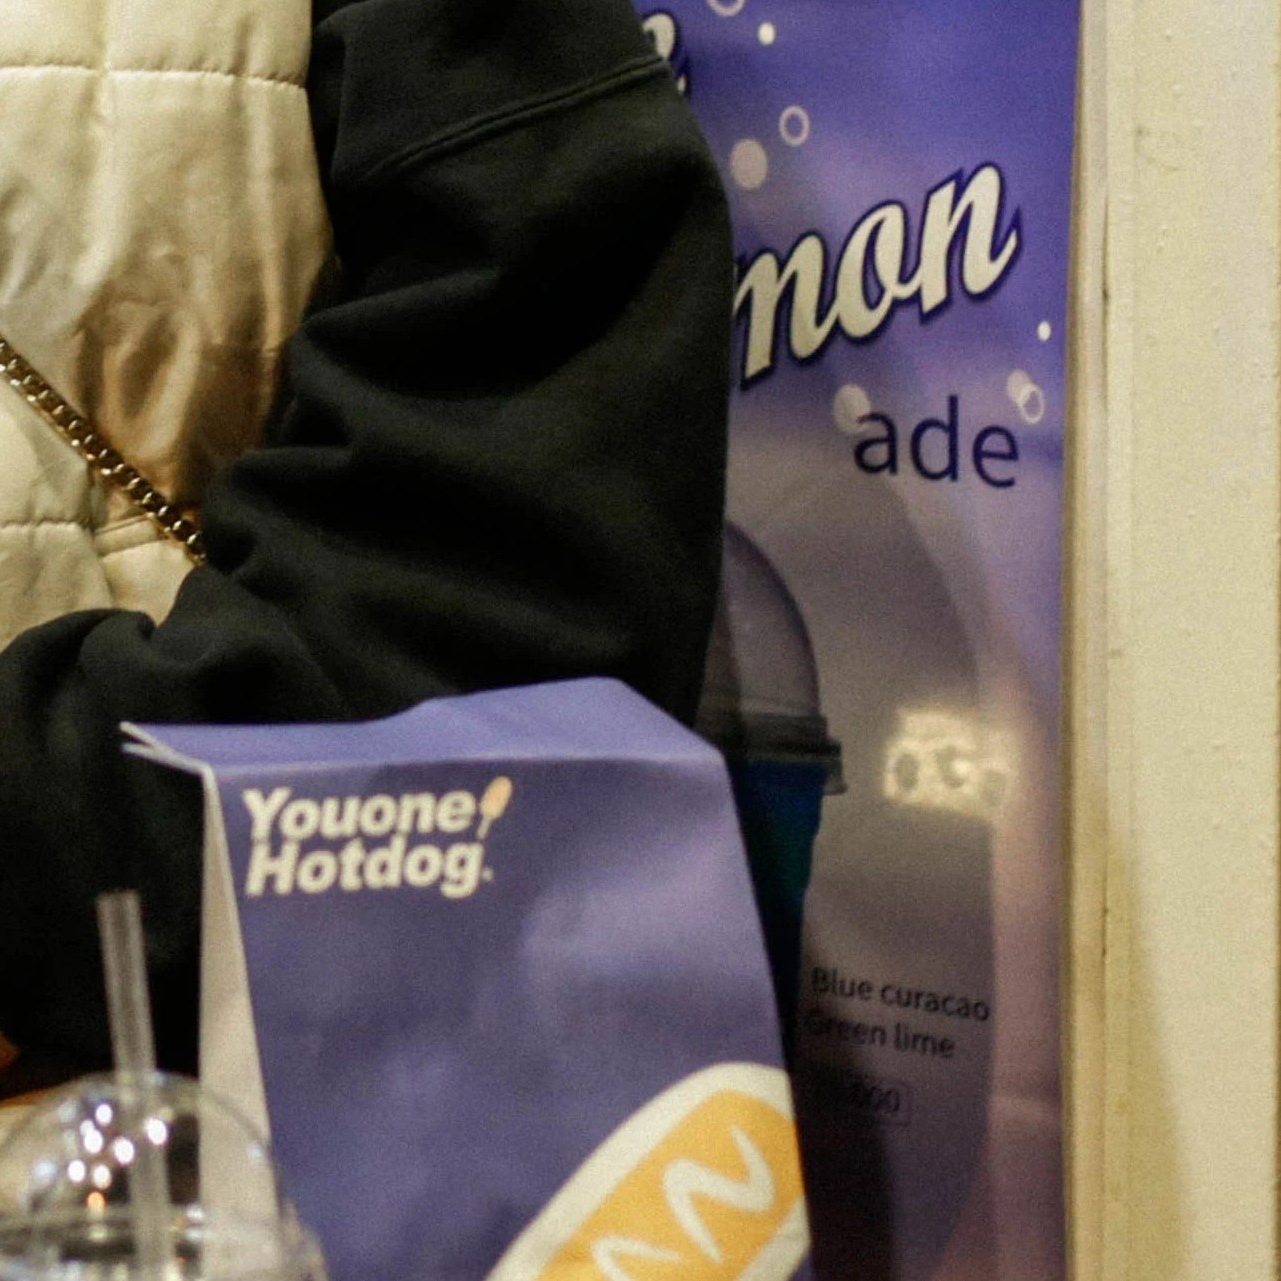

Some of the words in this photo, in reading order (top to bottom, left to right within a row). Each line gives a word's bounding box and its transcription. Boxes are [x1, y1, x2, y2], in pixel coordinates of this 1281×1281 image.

[733, 160, 1022, 386] mon
[852, 394, 1020, 489] ade
[242, 786, 476, 842] Youone
[811, 967, 873, 1001] Blue
[894, 1022, 956, 1059] lime
